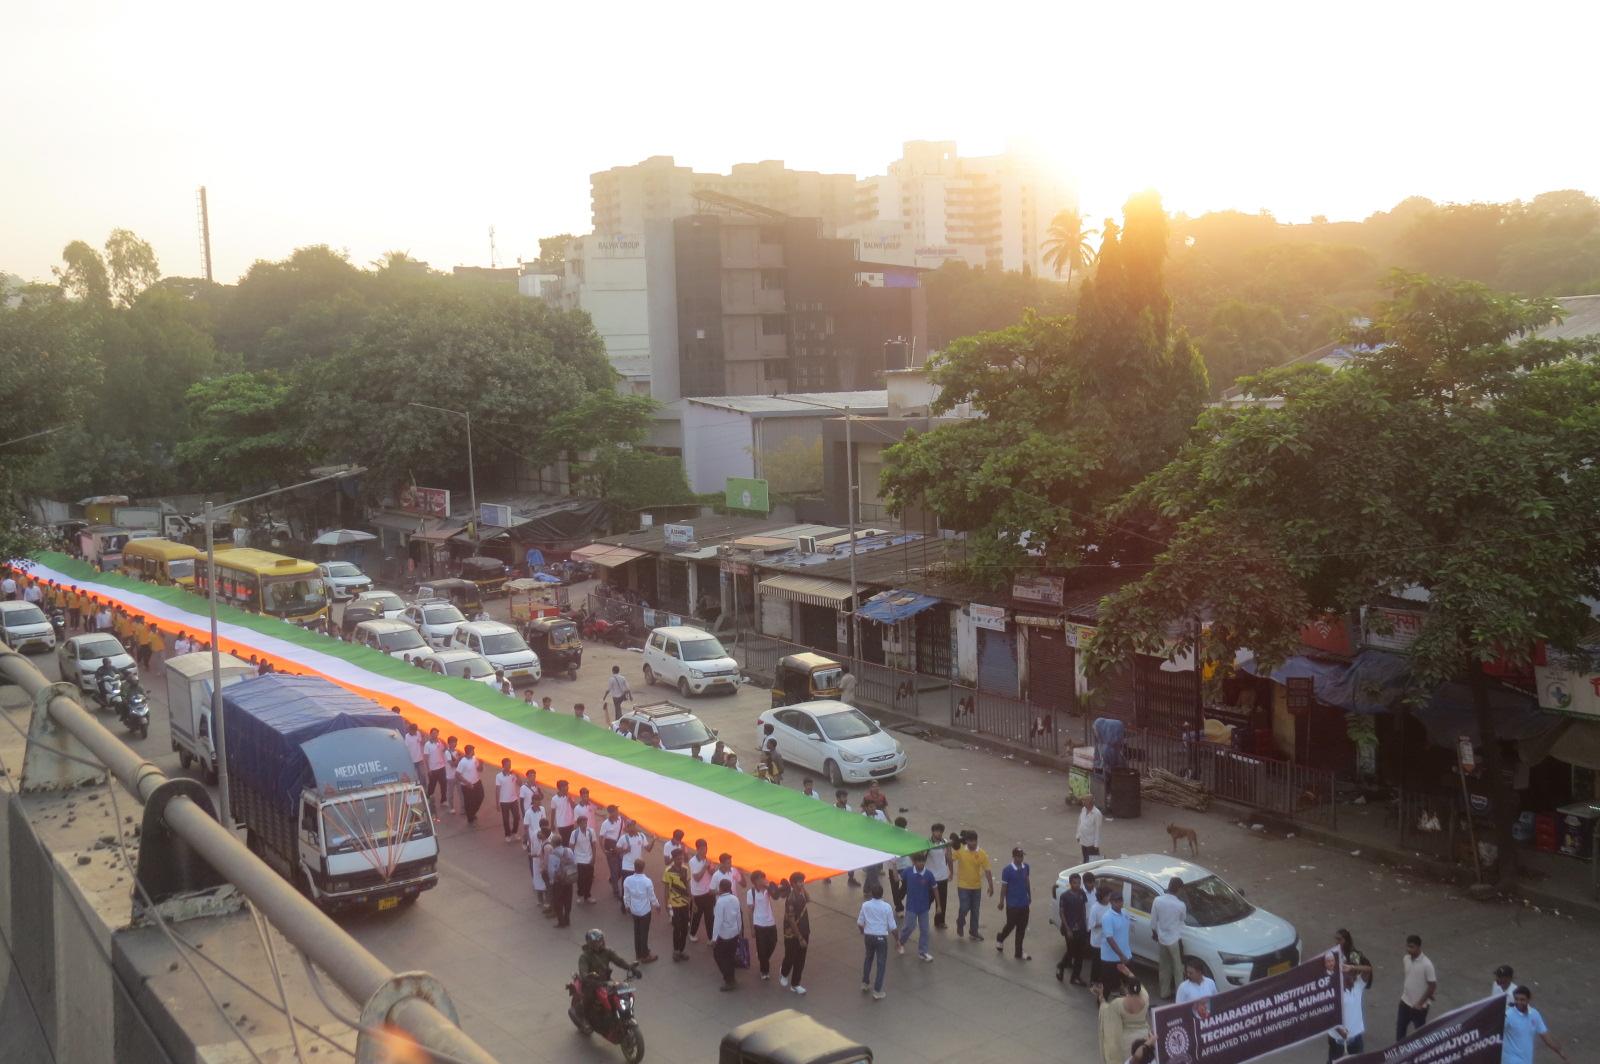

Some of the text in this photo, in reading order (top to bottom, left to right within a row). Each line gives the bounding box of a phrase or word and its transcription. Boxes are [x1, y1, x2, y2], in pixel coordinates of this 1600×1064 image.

[1200, 976, 1331, 1029] MAHARASHTRA INSTITUTE OF
[1200, 1012, 1264, 1043] TECHNOLOGY
[1298, 988, 1335, 1008] MUMBAI
[1201, 1003, 1335, 1057] AFFILIATED TO THE UNIVERSITY OF MUMBAI
[1398, 1039, 1423, 1056] PUNE
[1463, 1033, 1502, 1056] SCHOOL
